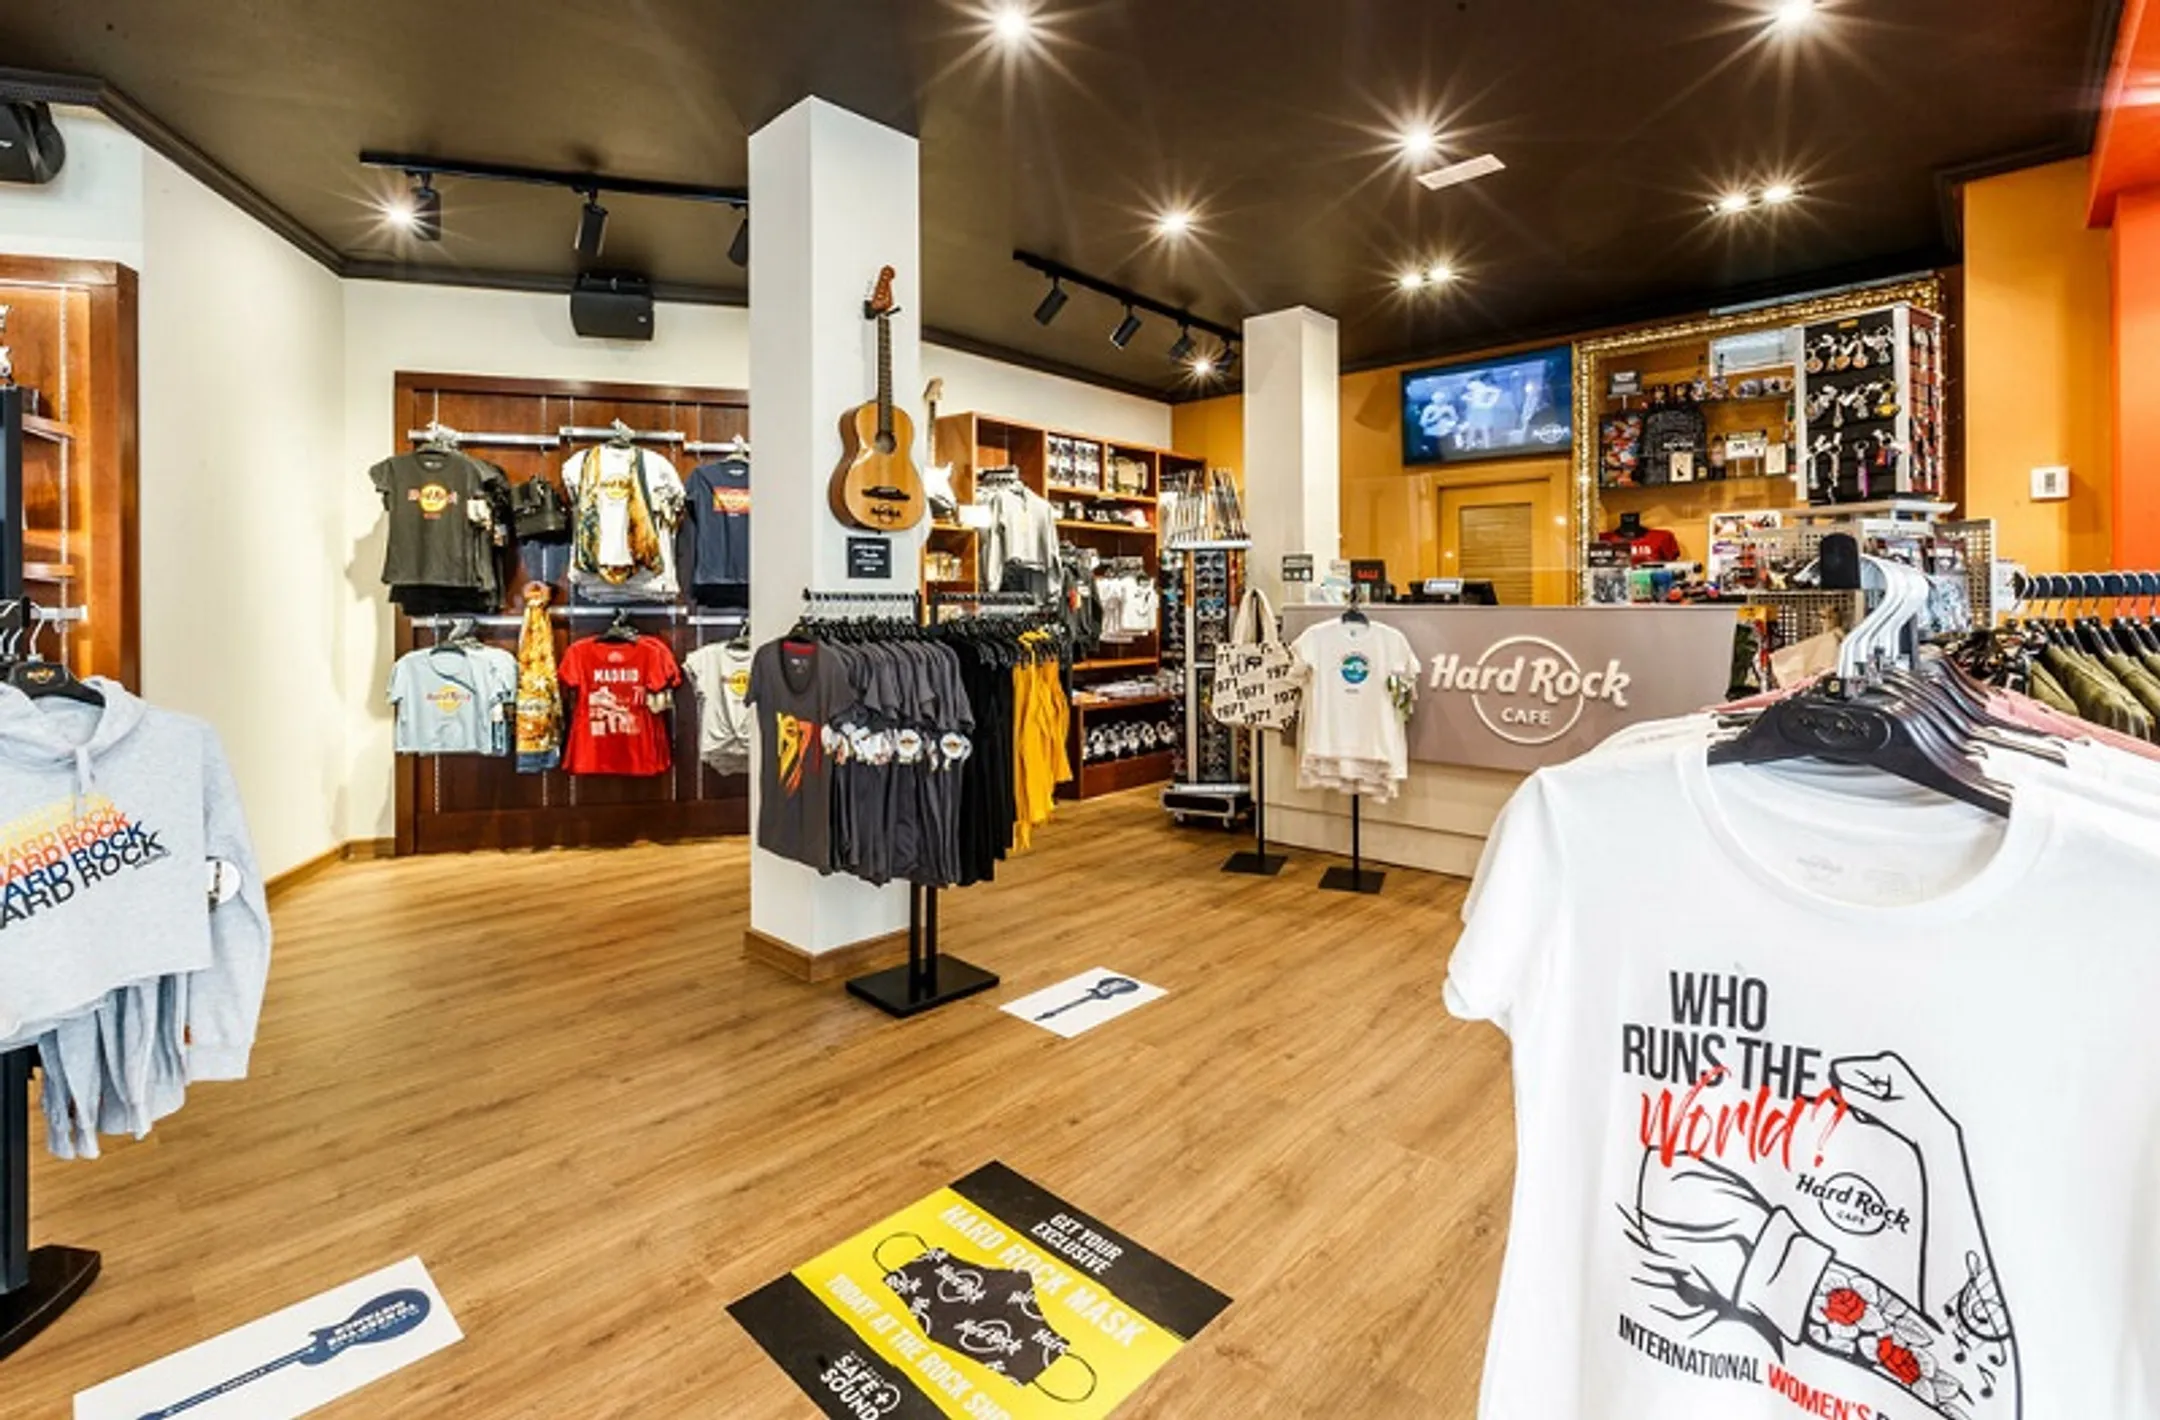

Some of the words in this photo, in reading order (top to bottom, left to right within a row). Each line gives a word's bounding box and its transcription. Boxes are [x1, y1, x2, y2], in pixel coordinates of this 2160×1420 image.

[594, 668, 639, 682] MADRID
[1428, 653, 1526, 694] Hard
[1528, 658, 1632, 708] Rock
[1500, 706, 1552, 727] CAFE
[0, 845, 62, 886] ARD
[65, 812, 132, 853] ROCK
[0, 878, 75, 930] ARD
[79, 829, 167, 889] ROCK
[1, 860, 70, 907] ARD
[71, 820, 149, 873] ROCK
[1669, 969, 1768, 1033] WHO
[1622, 1023, 1727, 1087] RUNS
[1736, 1036, 1822, 1104] THE
[1640, 1064, 1849, 1173] World?
[1795, 1173, 1854, 1205] Hard
[1855, 1190, 1911, 1235] Rock
[1030, 1221, 1113, 1276] EXCLUSIVE
[1050, 1213, 1084, 1235] GET
[1078, 1229, 1124, 1261] YOUR
[940, 1204, 1007, 1250] HARD
[1000, 1243, 1073, 1297] ROCK
[1060, 1284, 1150, 1347] MASK
[820, 1368, 879, 1420] SOUND
[834, 1355, 880, 1396] SAFE
[868, 1312, 900, 1335] AT
[886, 1326, 930, 1361] THE
[915, 1351, 974, 1401] ROCK
[963, 1391, 1013, 1420] SHO
[1617, 1312, 1764, 1385] INTERNATIONAL
[1767, 1361, 1872, 1420] WOMEN'S
